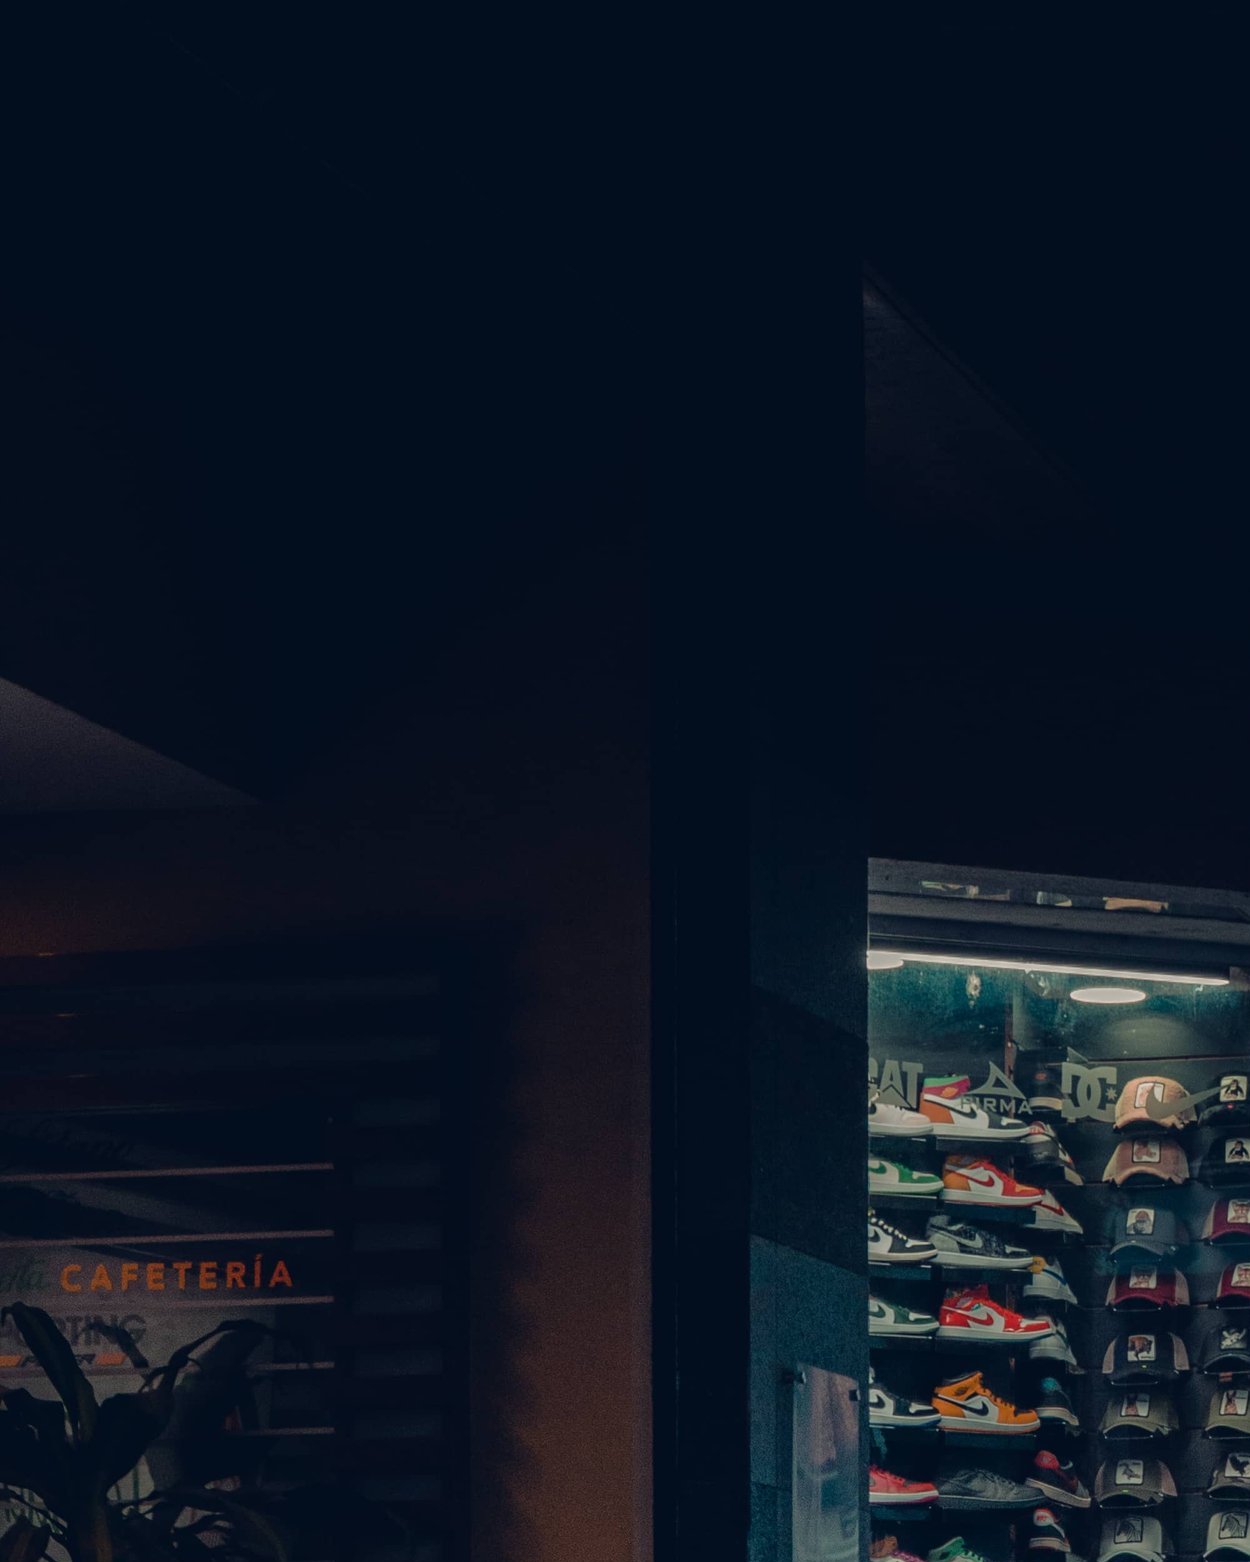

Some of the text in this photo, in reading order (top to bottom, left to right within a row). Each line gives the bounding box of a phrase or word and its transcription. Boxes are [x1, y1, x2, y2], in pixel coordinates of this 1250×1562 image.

[960, 1095, 1033, 1116] PIRMA
[1061, 1062, 1117, 1123] DC
[59, 1252, 294, 1293] CAFETERÍA
